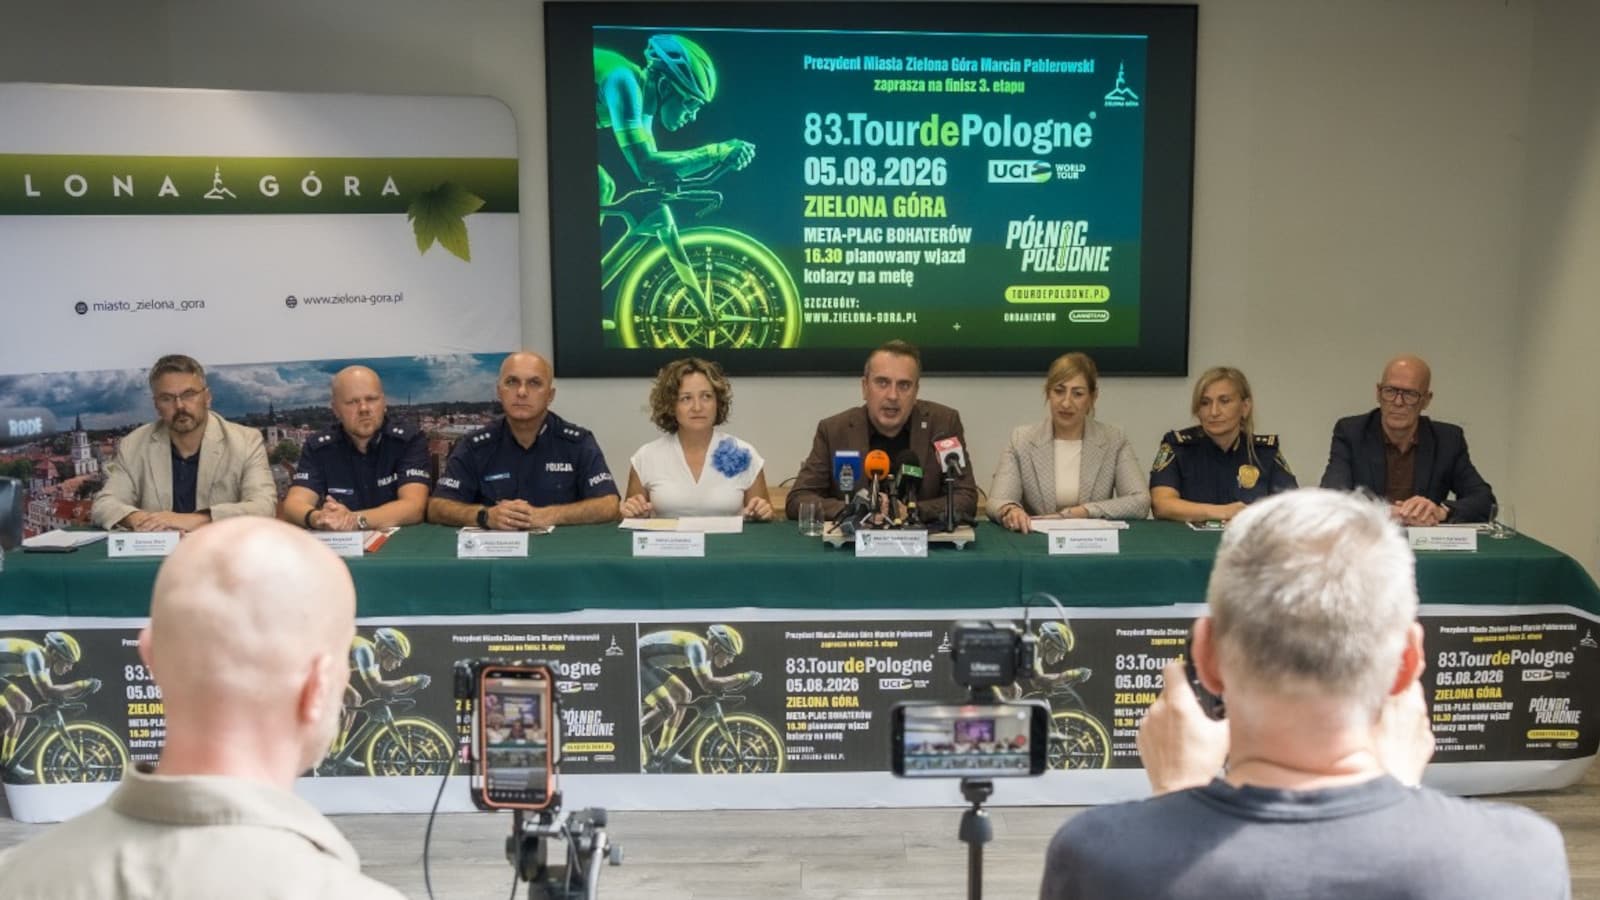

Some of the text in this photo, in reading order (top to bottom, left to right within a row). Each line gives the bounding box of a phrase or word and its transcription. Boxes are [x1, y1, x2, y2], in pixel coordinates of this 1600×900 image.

[804, 55, 1095, 73] Prezydent Miasta Zielona Góra Marcin Pabierowski
[874, 78, 1025, 94] zaprasza na finisz 3. etapu
[804, 112, 1093, 155] 83.TourdePologne
[804, 156, 947, 186] 05.08.2026
[993, 164, 1028, 178] UCI
[1055, 163, 1086, 172] WORLD
[1057, 171, 1079, 179] TOUR
[24, 170, 401, 197] LONA GÓRA
[804, 191, 947, 218] ZIELONA GÓRA
[804, 225, 973, 244] META-PLAC BOHATERÓW
[1006, 214, 1089, 249] PÓŁNOC
[804, 248, 966, 265] 16.30 planowany wjazd
[1021, 246, 1112, 272] POŁUDNIE
[804, 269, 914, 287] kolarzy na metę
[93, 299, 205, 313] miasto_zielona_gora
[303, 292, 404, 306] www.zielona-gora.pl
[804, 312, 917, 323] WWW.ZIELONA-GORA.PL
[545, 462, 573, 472] POLICJA
[786, 678, 859, 692] 05.08.2026
[1436, 670, 1504, 686] 05.08.2026
[1435, 685, 1502, 700] ZIELONA GÓRA
[786, 694, 859, 708] ZIELONA GÓRA
